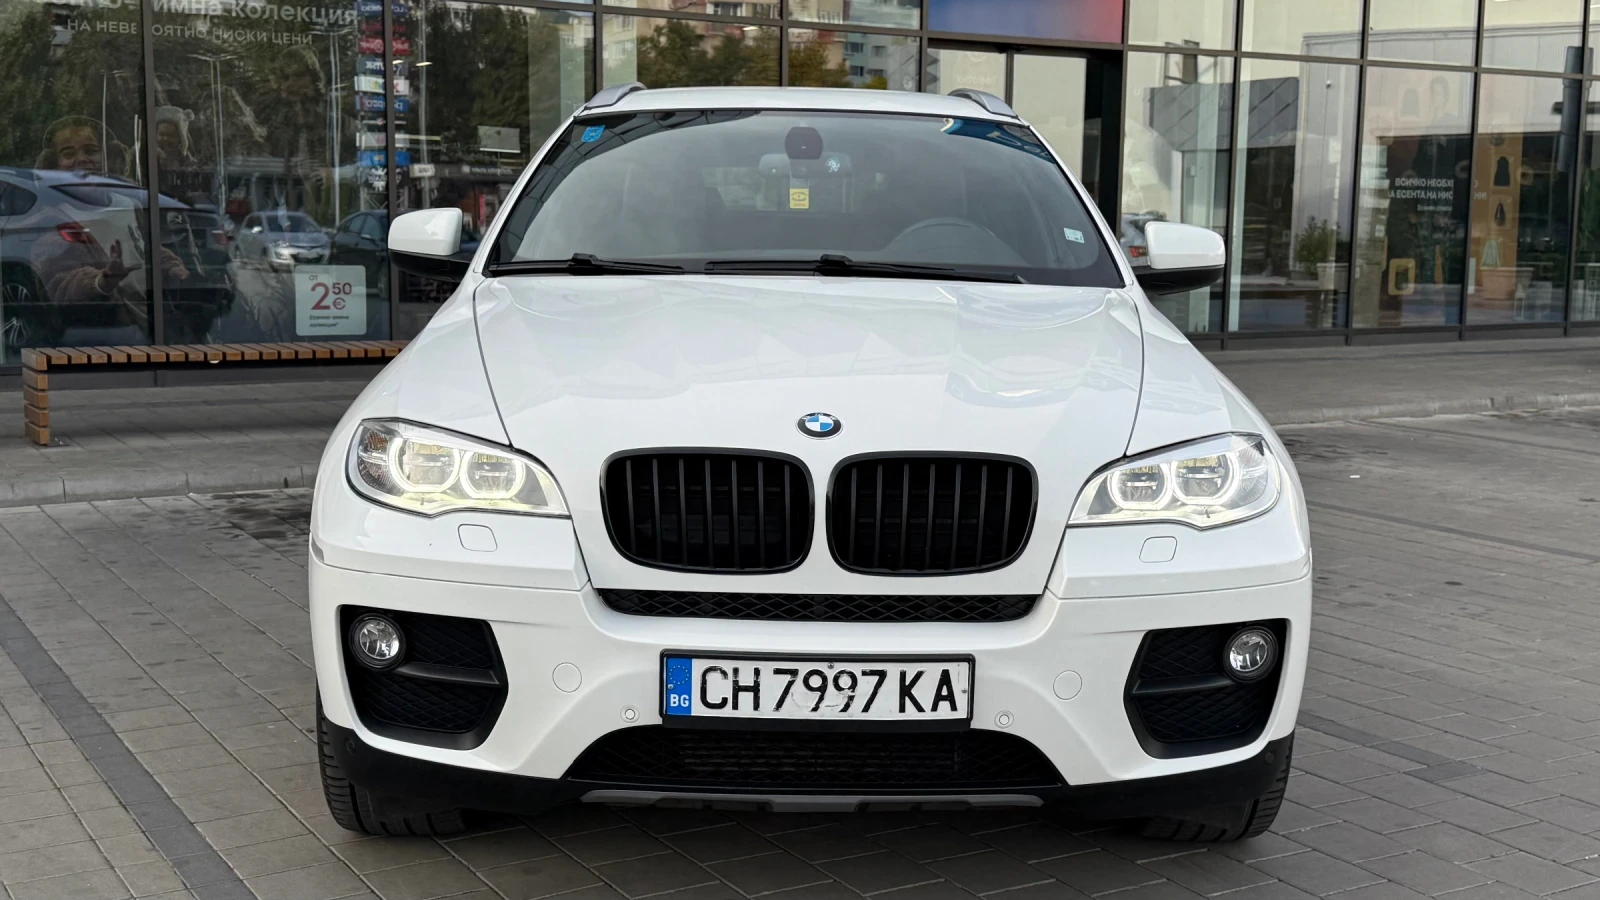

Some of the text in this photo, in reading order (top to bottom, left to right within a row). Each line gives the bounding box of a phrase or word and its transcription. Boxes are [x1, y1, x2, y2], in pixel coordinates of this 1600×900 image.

[231, 2, 357, 26] колекция
[67, 19, 313, 46] НА НЕВЕОЯТНО НИСКИ ЦЕНИ
[1395, 178, 1426, 187] ВСИЧКО
[1396, 190, 1425, 199] ЕСЕНТА
[311, 282, 352, 310] 2 50 €
[670, 665, 958, 713] BG CH 7997 KA
